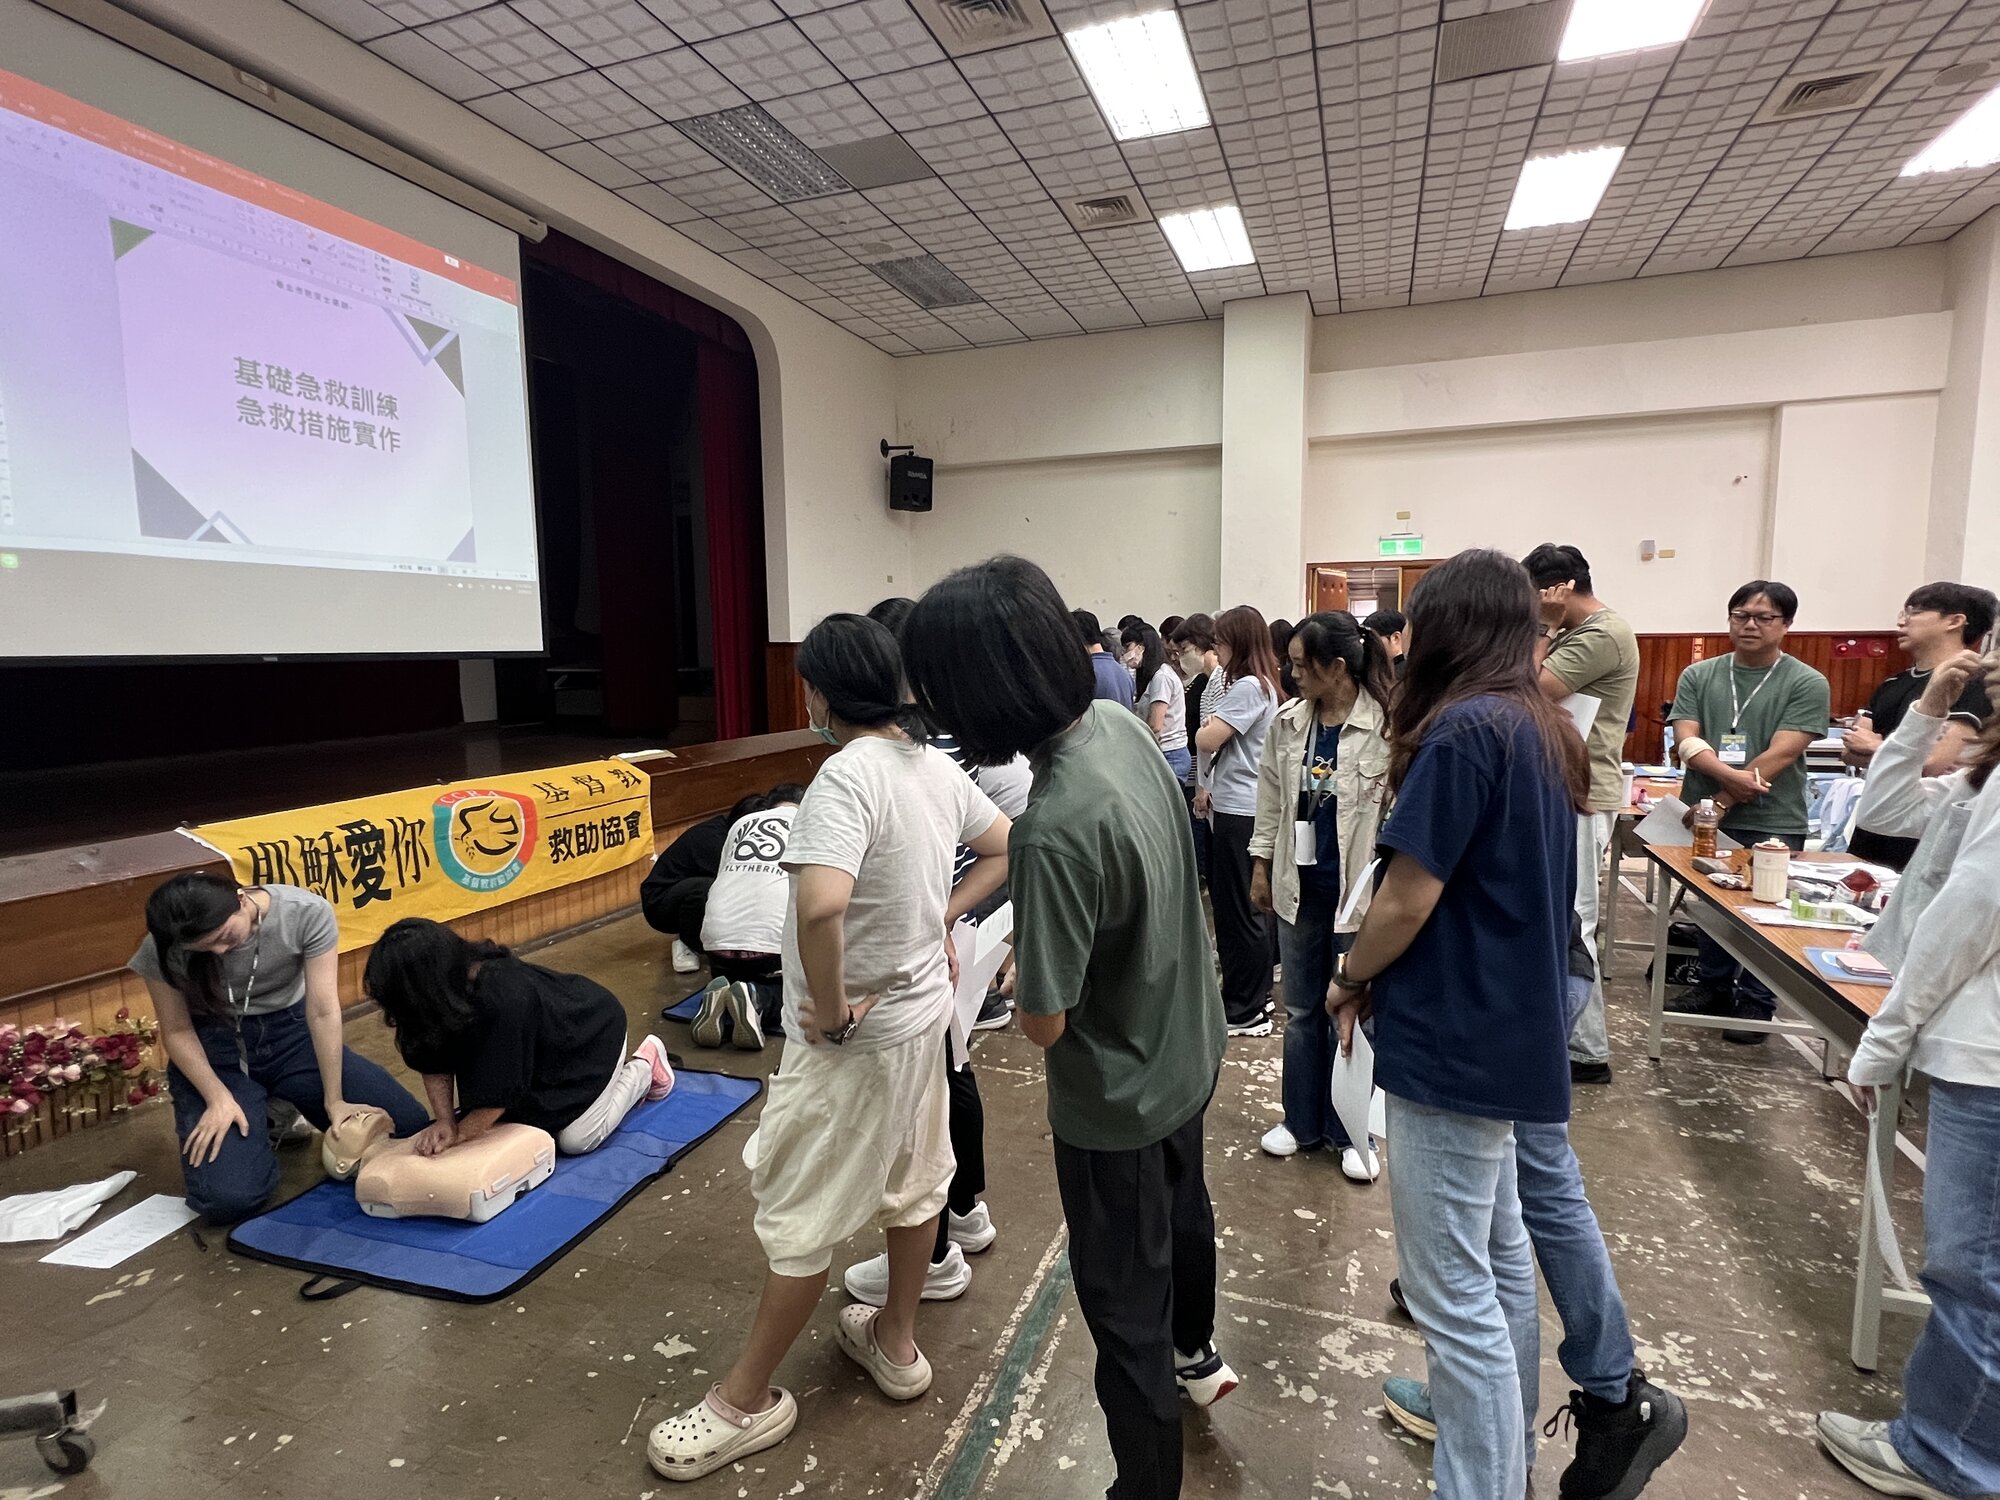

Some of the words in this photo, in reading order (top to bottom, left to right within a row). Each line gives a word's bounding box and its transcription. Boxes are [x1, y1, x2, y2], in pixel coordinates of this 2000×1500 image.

[233, 356, 399, 421] 基礎急救訓練
[236, 395, 401, 453] 急救措施實作
[239, 816, 430, 910] 耶穌愛你
[548, 810, 641, 865] 救助協會
